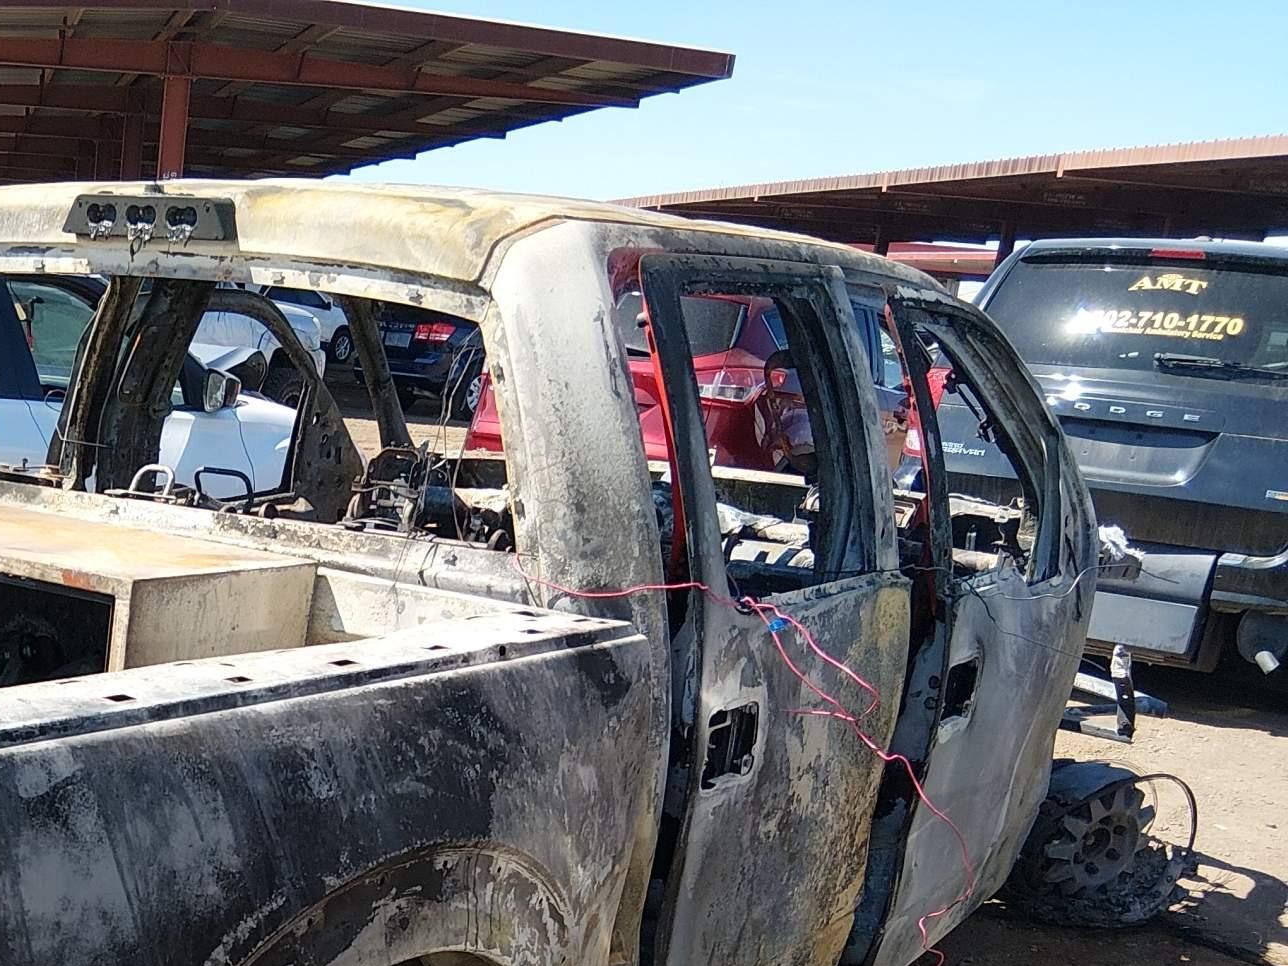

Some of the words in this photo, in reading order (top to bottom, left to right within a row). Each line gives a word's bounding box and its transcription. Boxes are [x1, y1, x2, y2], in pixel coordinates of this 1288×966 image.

[1128, 274, 1208, 295] AMT
[1088, 309, 1244, 336] 02-710-1770
[1192, 331, 1224, 341] Service
[1047, 396, 1200, 422] ODGE
